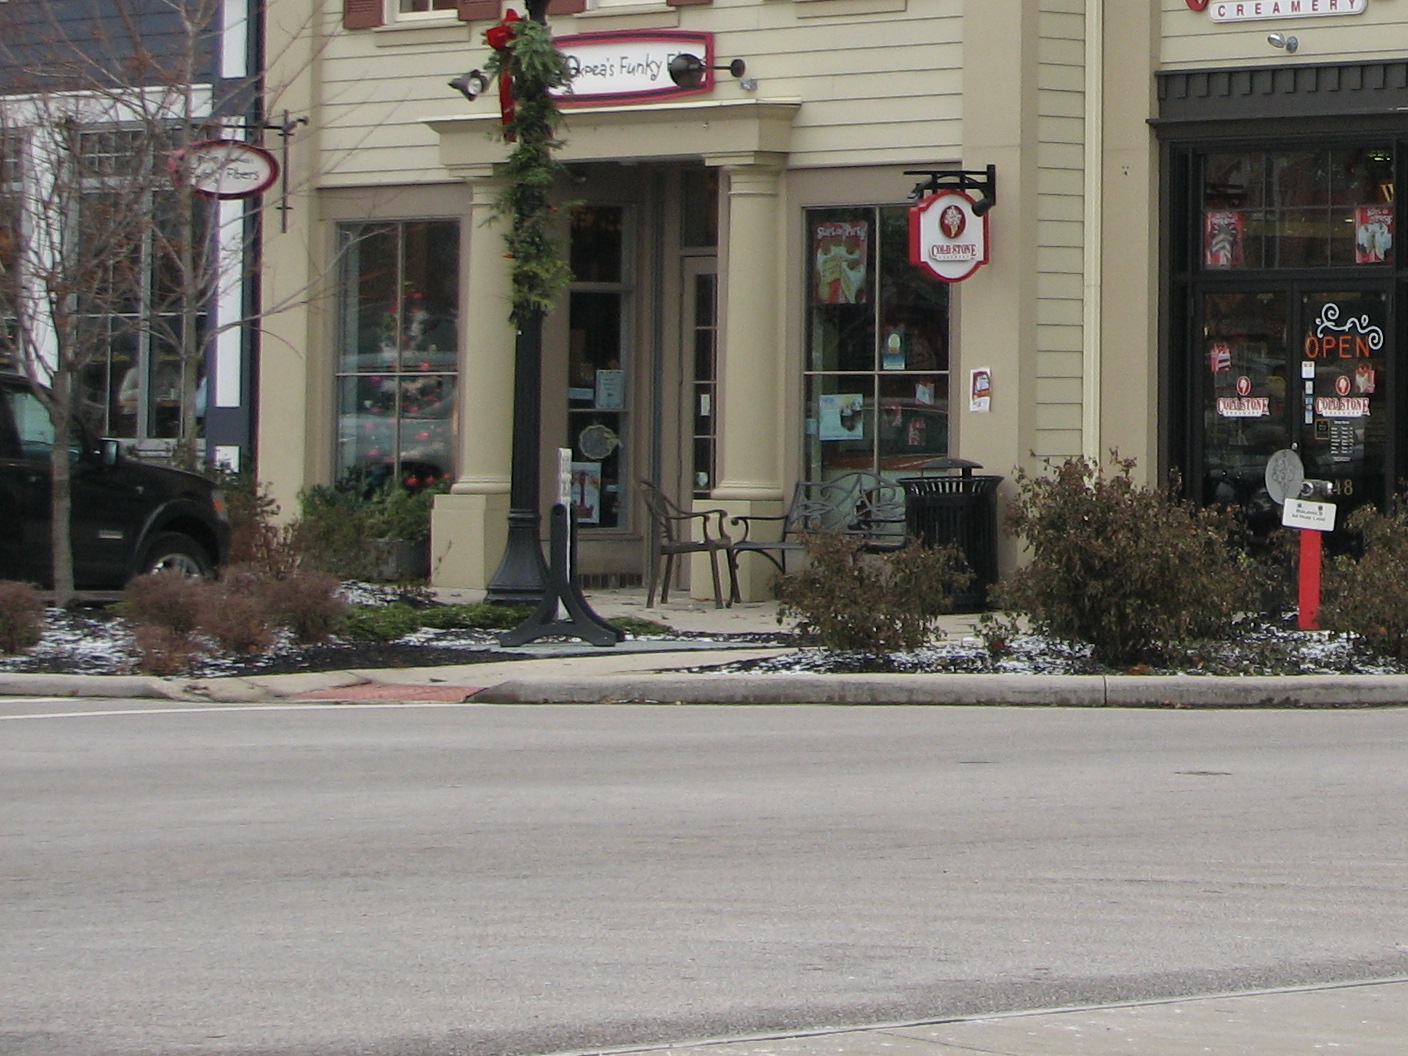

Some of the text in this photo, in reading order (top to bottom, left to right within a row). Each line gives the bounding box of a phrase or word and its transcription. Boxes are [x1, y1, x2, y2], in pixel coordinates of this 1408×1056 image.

[620, 53, 662, 81] Funky
[931, 243, 977, 257] COLD STONE
[1305, 335, 1370, 359] OPEN
[1240, 397, 1270, 415] STONE
[1339, 397, 1370, 415] STONE
